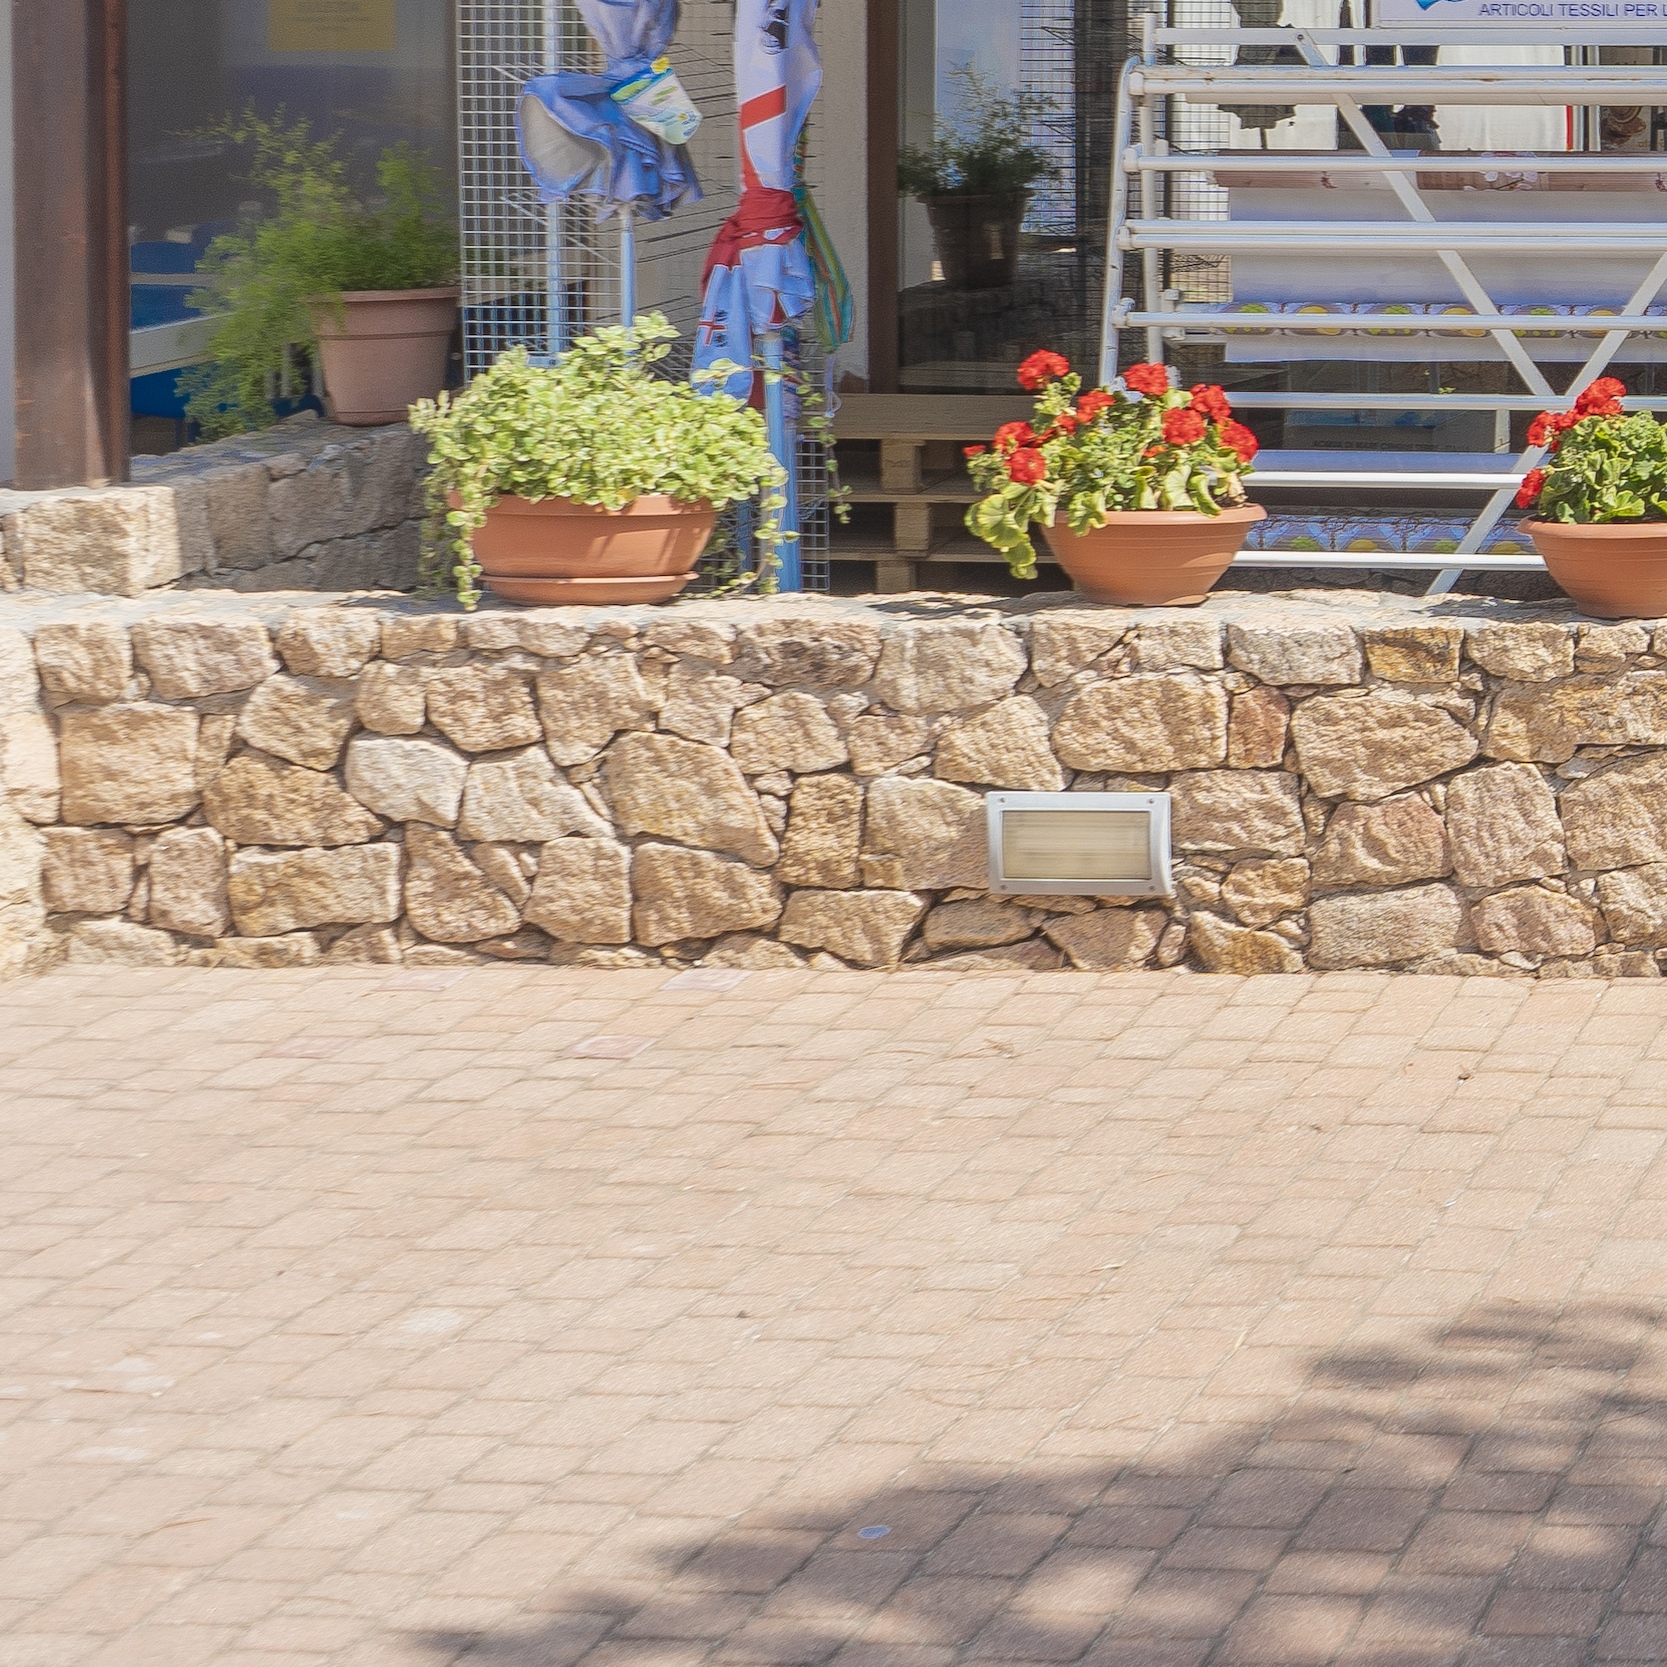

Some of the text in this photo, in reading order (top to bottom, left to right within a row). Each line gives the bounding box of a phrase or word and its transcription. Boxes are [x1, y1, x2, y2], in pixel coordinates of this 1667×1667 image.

[1478, 2, 1554, 17] ARTICOLI
[1557, 2, 1619, 17] TESSILI
[1623, 2, 1657, 17] PER
